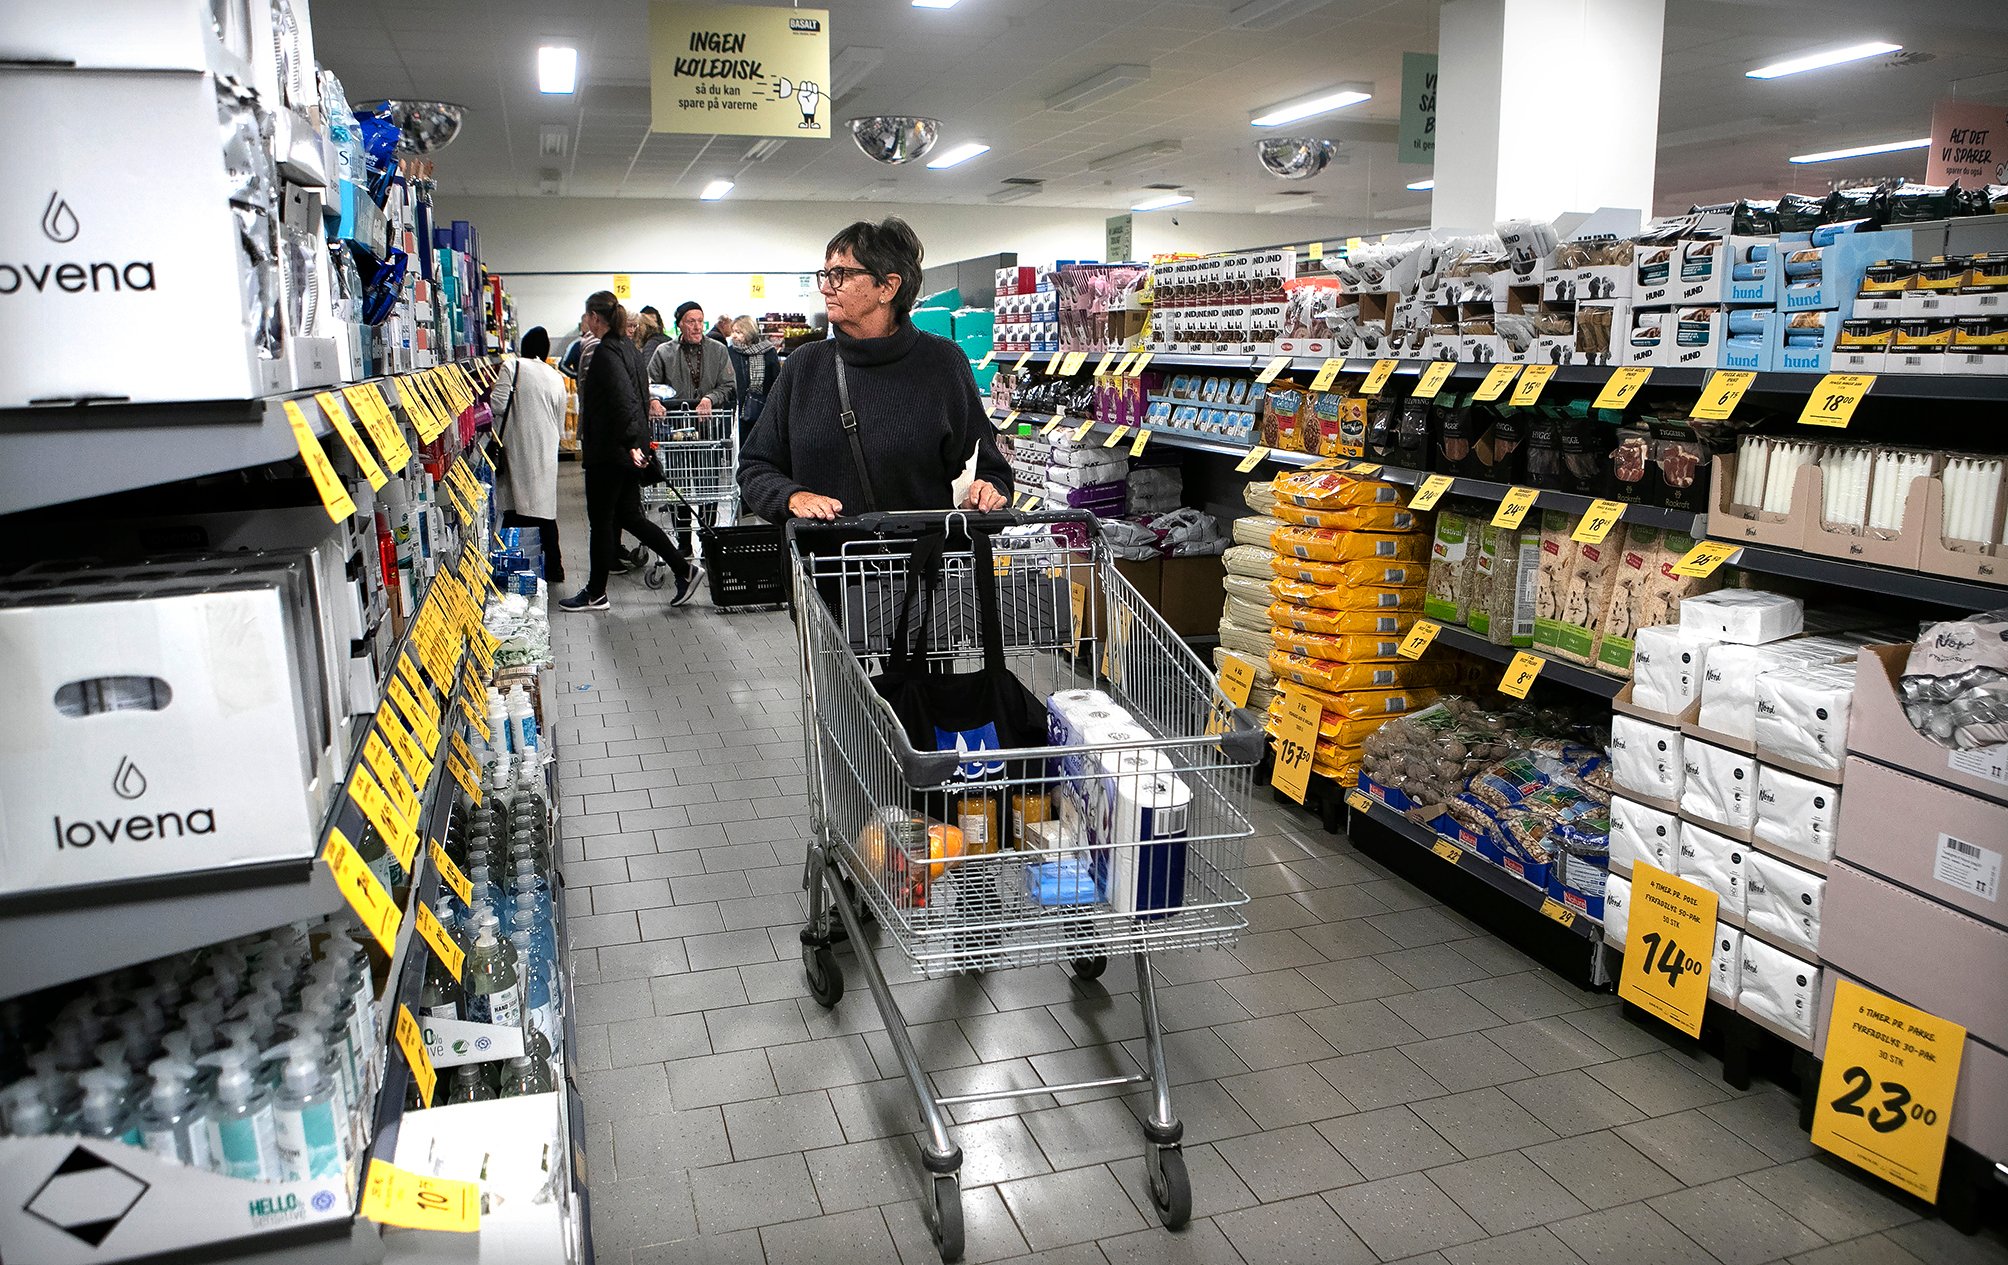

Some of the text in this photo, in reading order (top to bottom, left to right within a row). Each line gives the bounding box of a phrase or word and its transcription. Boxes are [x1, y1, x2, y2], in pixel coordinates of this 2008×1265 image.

[789, 18, 819, 30] BASALT
[689, 31, 746, 53] INGEN
[695, 82, 740, 96] så du kan
[678, 97, 758, 111] spare på varerne
[1949, 128, 1990, 145] ALT DET
[1413, 139, 1421, 149] til
[1942, 147, 1992, 164] VI SPARER
[1945, 166, 1982, 177] sparer du også
[1502, 234, 1520, 245] HUND
[1517, 275, 1531, 283] HUND
[1545, 275, 1559, 283] HUND
[1577, 271, 1592, 281] HUND
[1645, 289, 1665, 301] HUND
[1683, 285, 1704, 299] HUND
[1732, 285, 1763, 299] hund
[1787, 290, 1822, 307] hund
[1633, 350, 1653, 361] HUND
[1680, 350, 1701, 363] HUND
[1726, 352, 1759, 368] hund
[1783, 352, 1820, 369] hund
[1440, 526, 1462, 537] festival
[1668, 533, 1692, 545] festival
[1635, 652, 1650, 663] Nord
[1705, 667, 1722, 682] Nord
[1757, 700, 1775, 715] Nord
[1613, 737, 1627, 749] Nord
[1685, 763, 1700, 776] Nord
[1758, 788, 1776, 803] Nord
[53, 808, 216, 850] lovena
[1610, 818, 1625, 830] Nord
[1681, 845, 1696, 858] Nord
[1655, 882, 1672, 896] TIMER
[1748, 880, 1766, 894] Nord
[1606, 895, 1622, 908] Nord
[1662, 915, 1681, 929] 50 STK
[1678, 908, 1702, 924] 50-PAK
[1743, 958, 1758, 974] Nord
[494, 1003, 509, 1013] HAND
[1858, 1006, 1865, 1015] 6
[1866, 1008, 1892, 1025] TIMER
[1852, 1022, 1937, 1064] FYRFADSLYS 30-PAK
[1878, 1049, 1904, 1068] 30 STK
[249, 1192, 297, 1217] HELLO
